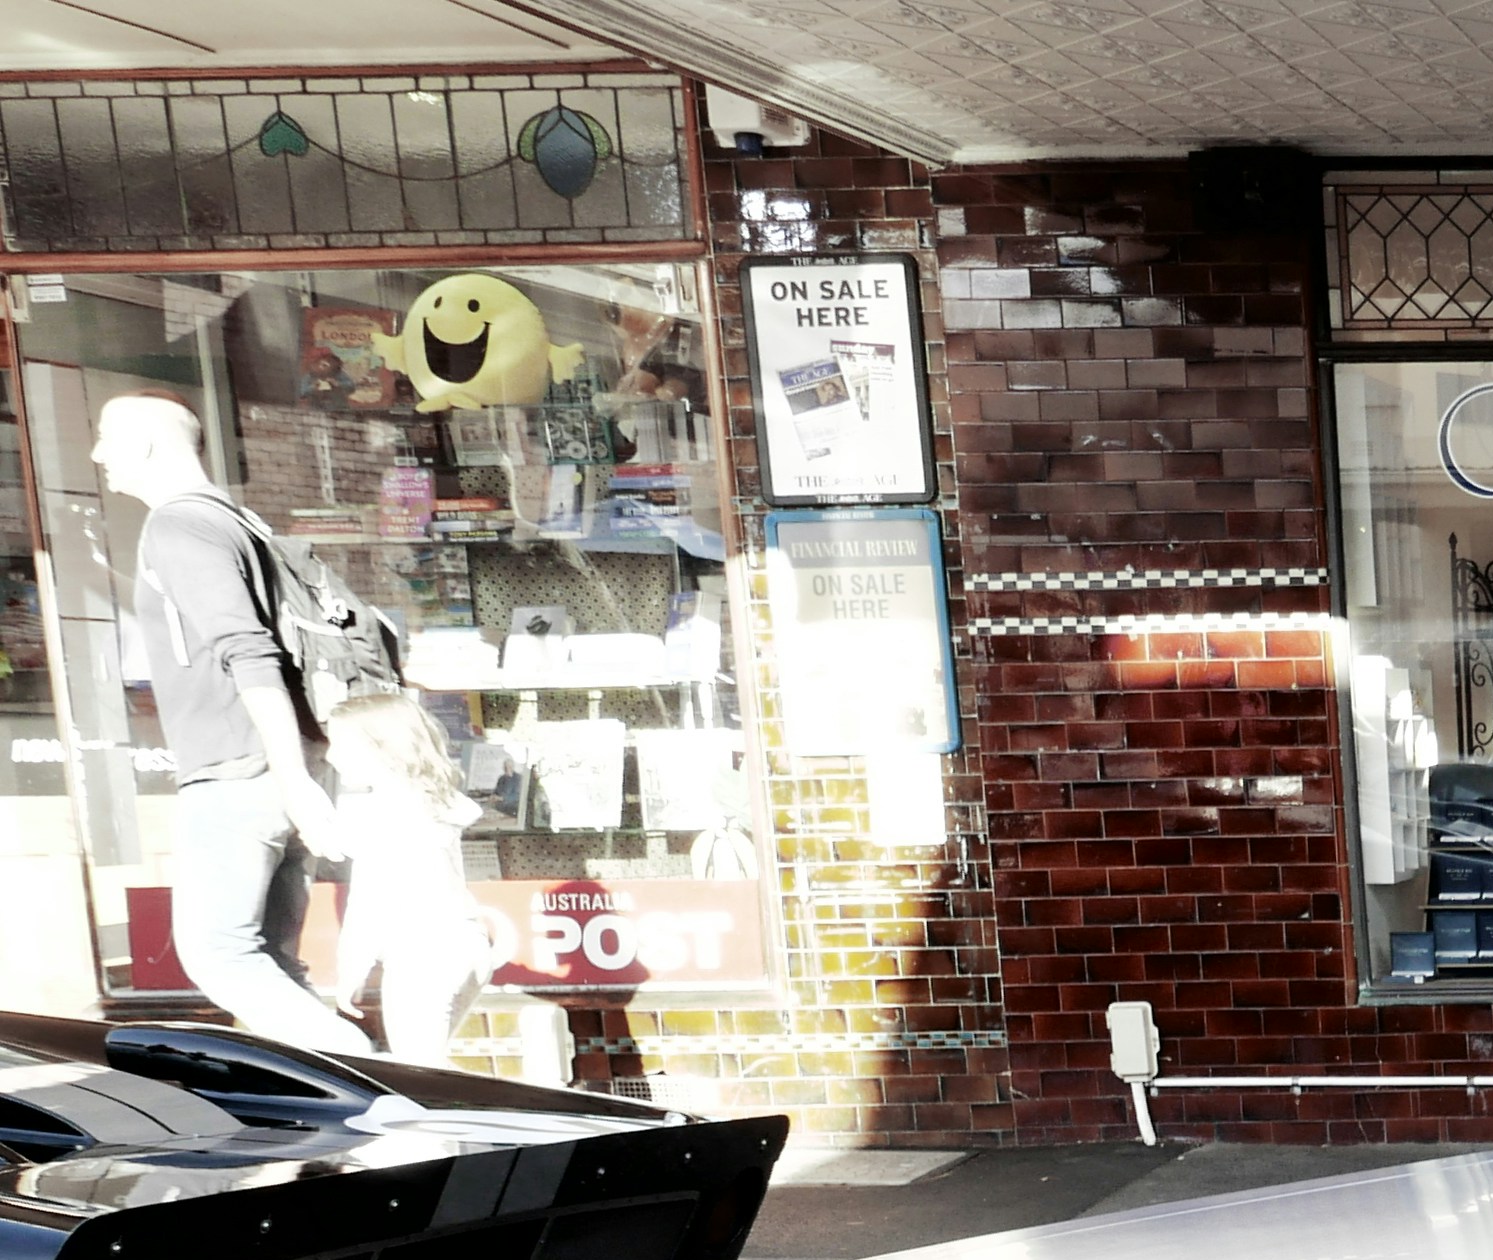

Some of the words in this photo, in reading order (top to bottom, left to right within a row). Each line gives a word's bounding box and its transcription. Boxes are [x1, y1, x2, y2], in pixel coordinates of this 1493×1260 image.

[790, 257, 812, 266] THE
[771, 281, 808, 301] ON
[820, 280, 889, 300] SALE
[796, 307, 869, 327] HERE
[794, 475, 827, 488] THE
[816, 495, 837, 504] THE
[862, 494, 883, 502] AGE
[791, 541, 863, 559] FINANCIAL
[865, 539, 918, 556] REVIEW
[812, 575, 842, 596] ON
[851, 573, 906, 595] SALE
[833, 599, 890, 620] HERE
[531, 911, 733, 971] POST
